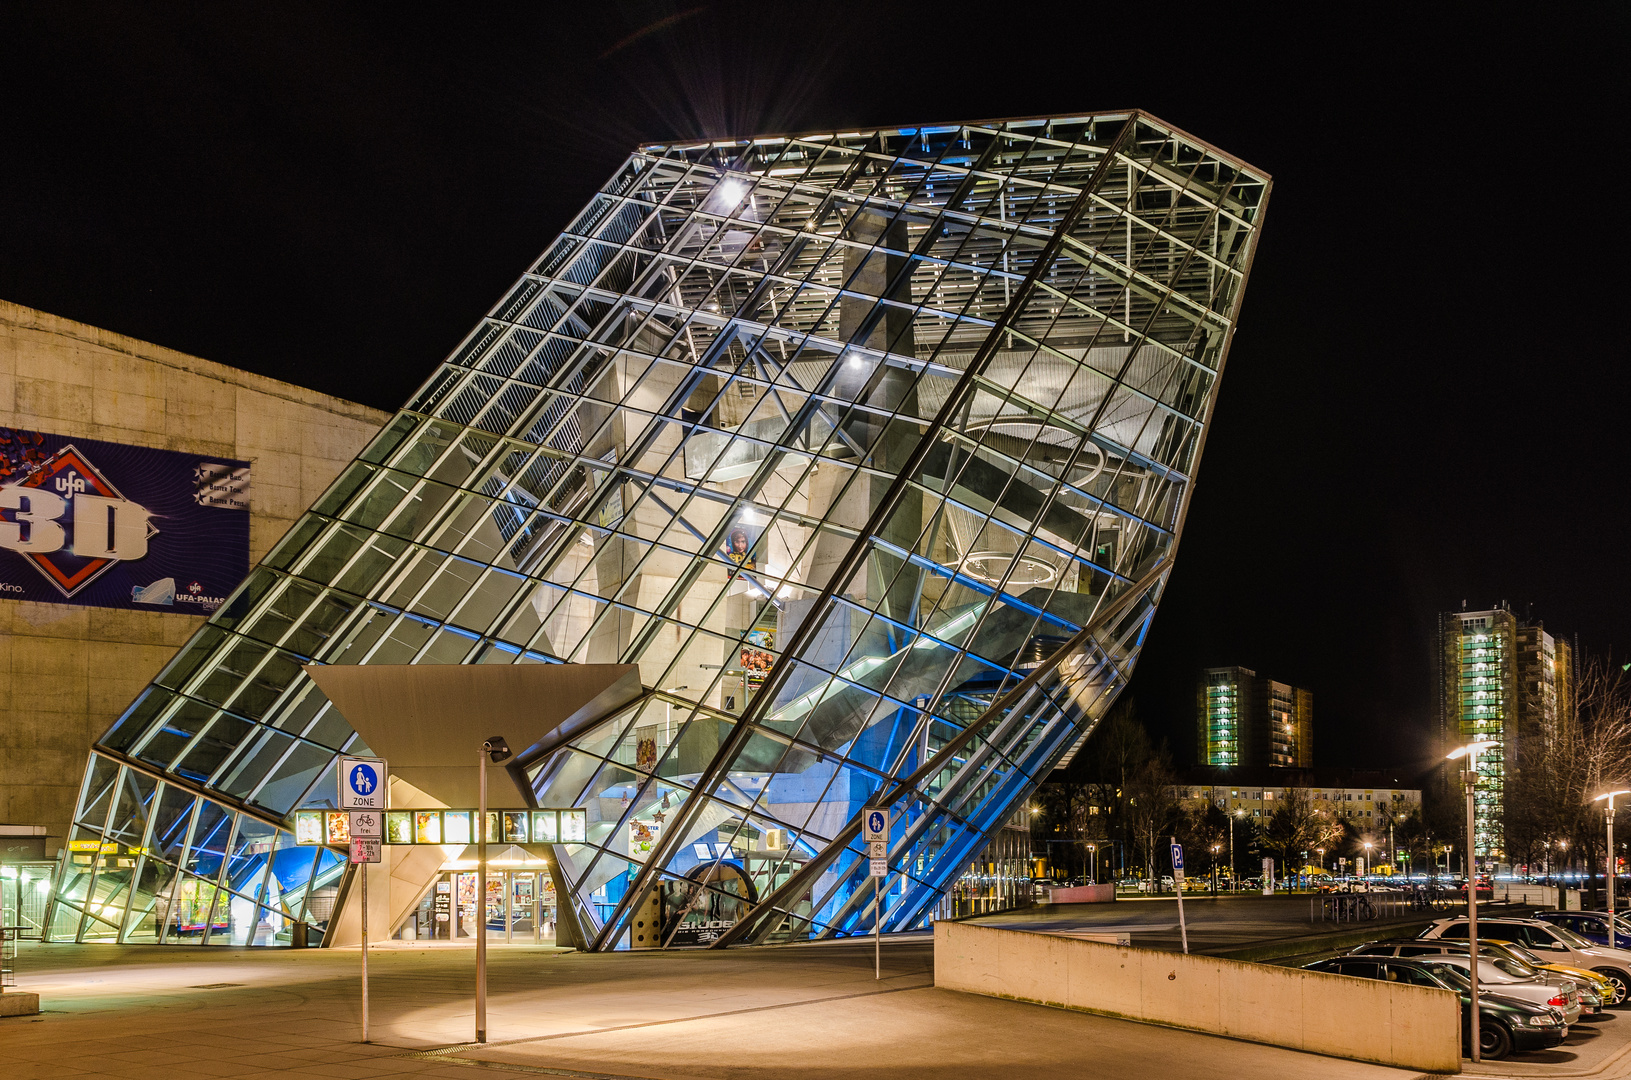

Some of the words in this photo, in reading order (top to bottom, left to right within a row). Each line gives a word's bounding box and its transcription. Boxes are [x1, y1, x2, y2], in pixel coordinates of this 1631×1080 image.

[0, 485, 149, 561] 3D
[0, 582, 25, 593] Kino.
[353, 797, 374, 806] ZONE
[1173, 847, 1180, 866] P
